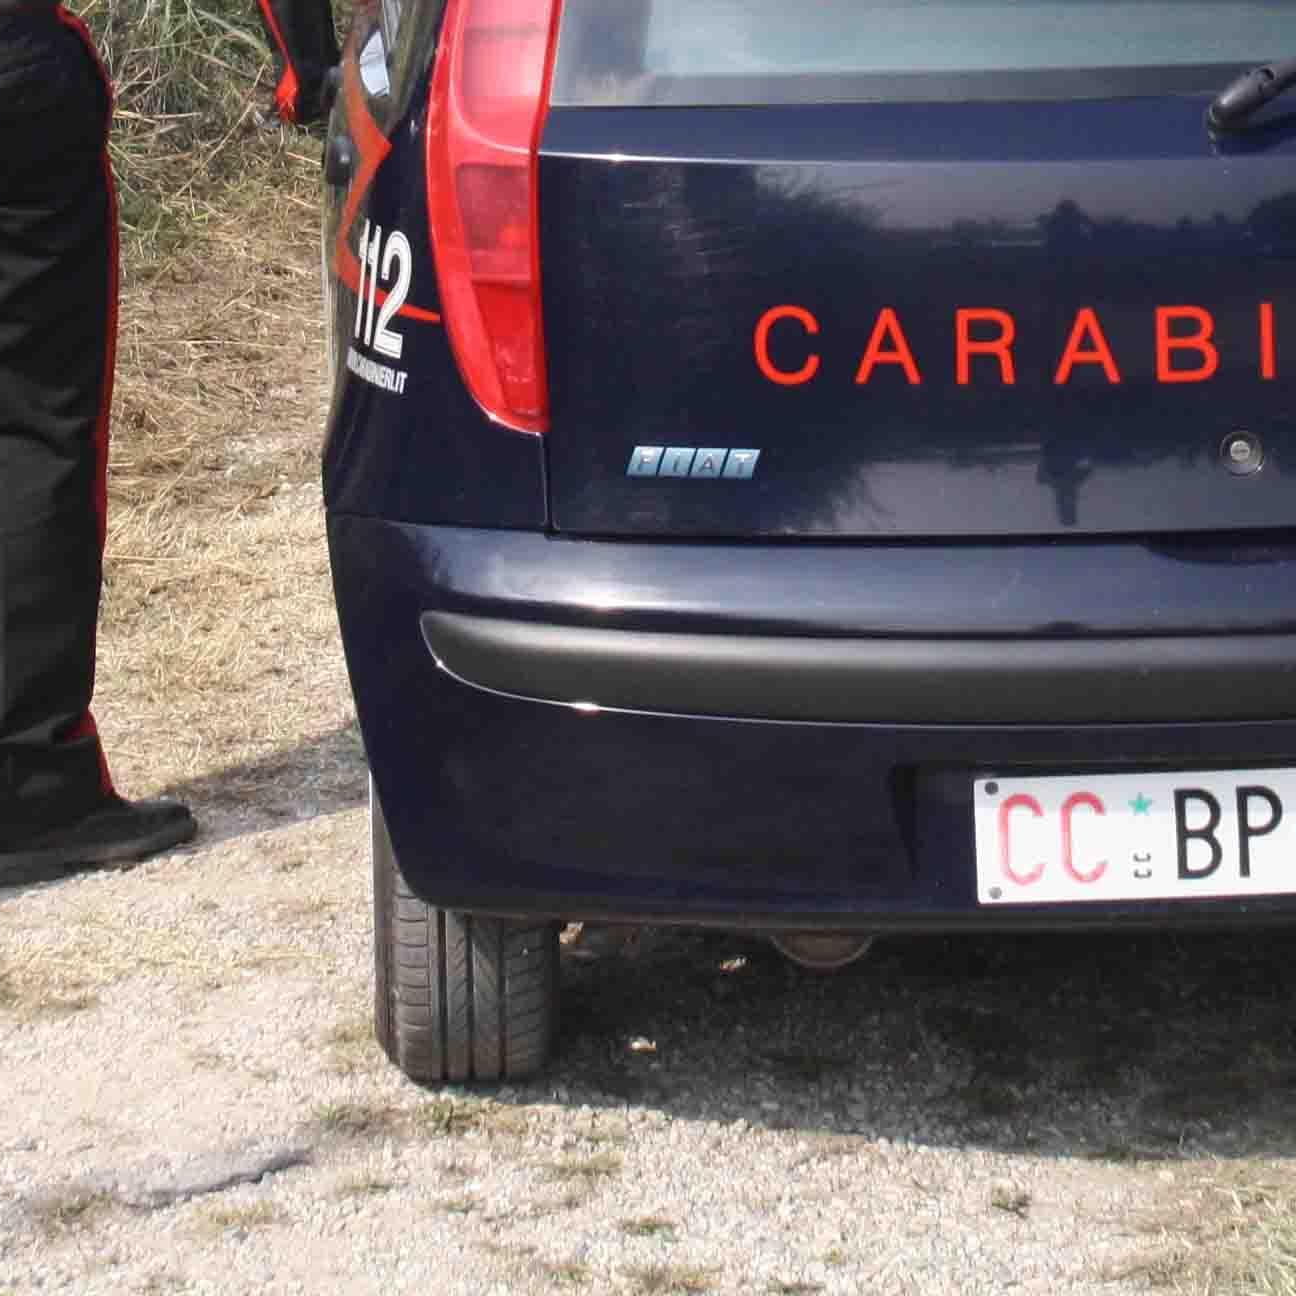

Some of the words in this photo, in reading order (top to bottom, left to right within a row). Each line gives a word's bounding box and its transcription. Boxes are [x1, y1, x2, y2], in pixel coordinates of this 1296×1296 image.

[355, 218, 412, 359] 112
[627, 446, 760, 477] FIAT
[999, 793, 1106, 886] CC
[1173, 785, 1283, 879] BP
